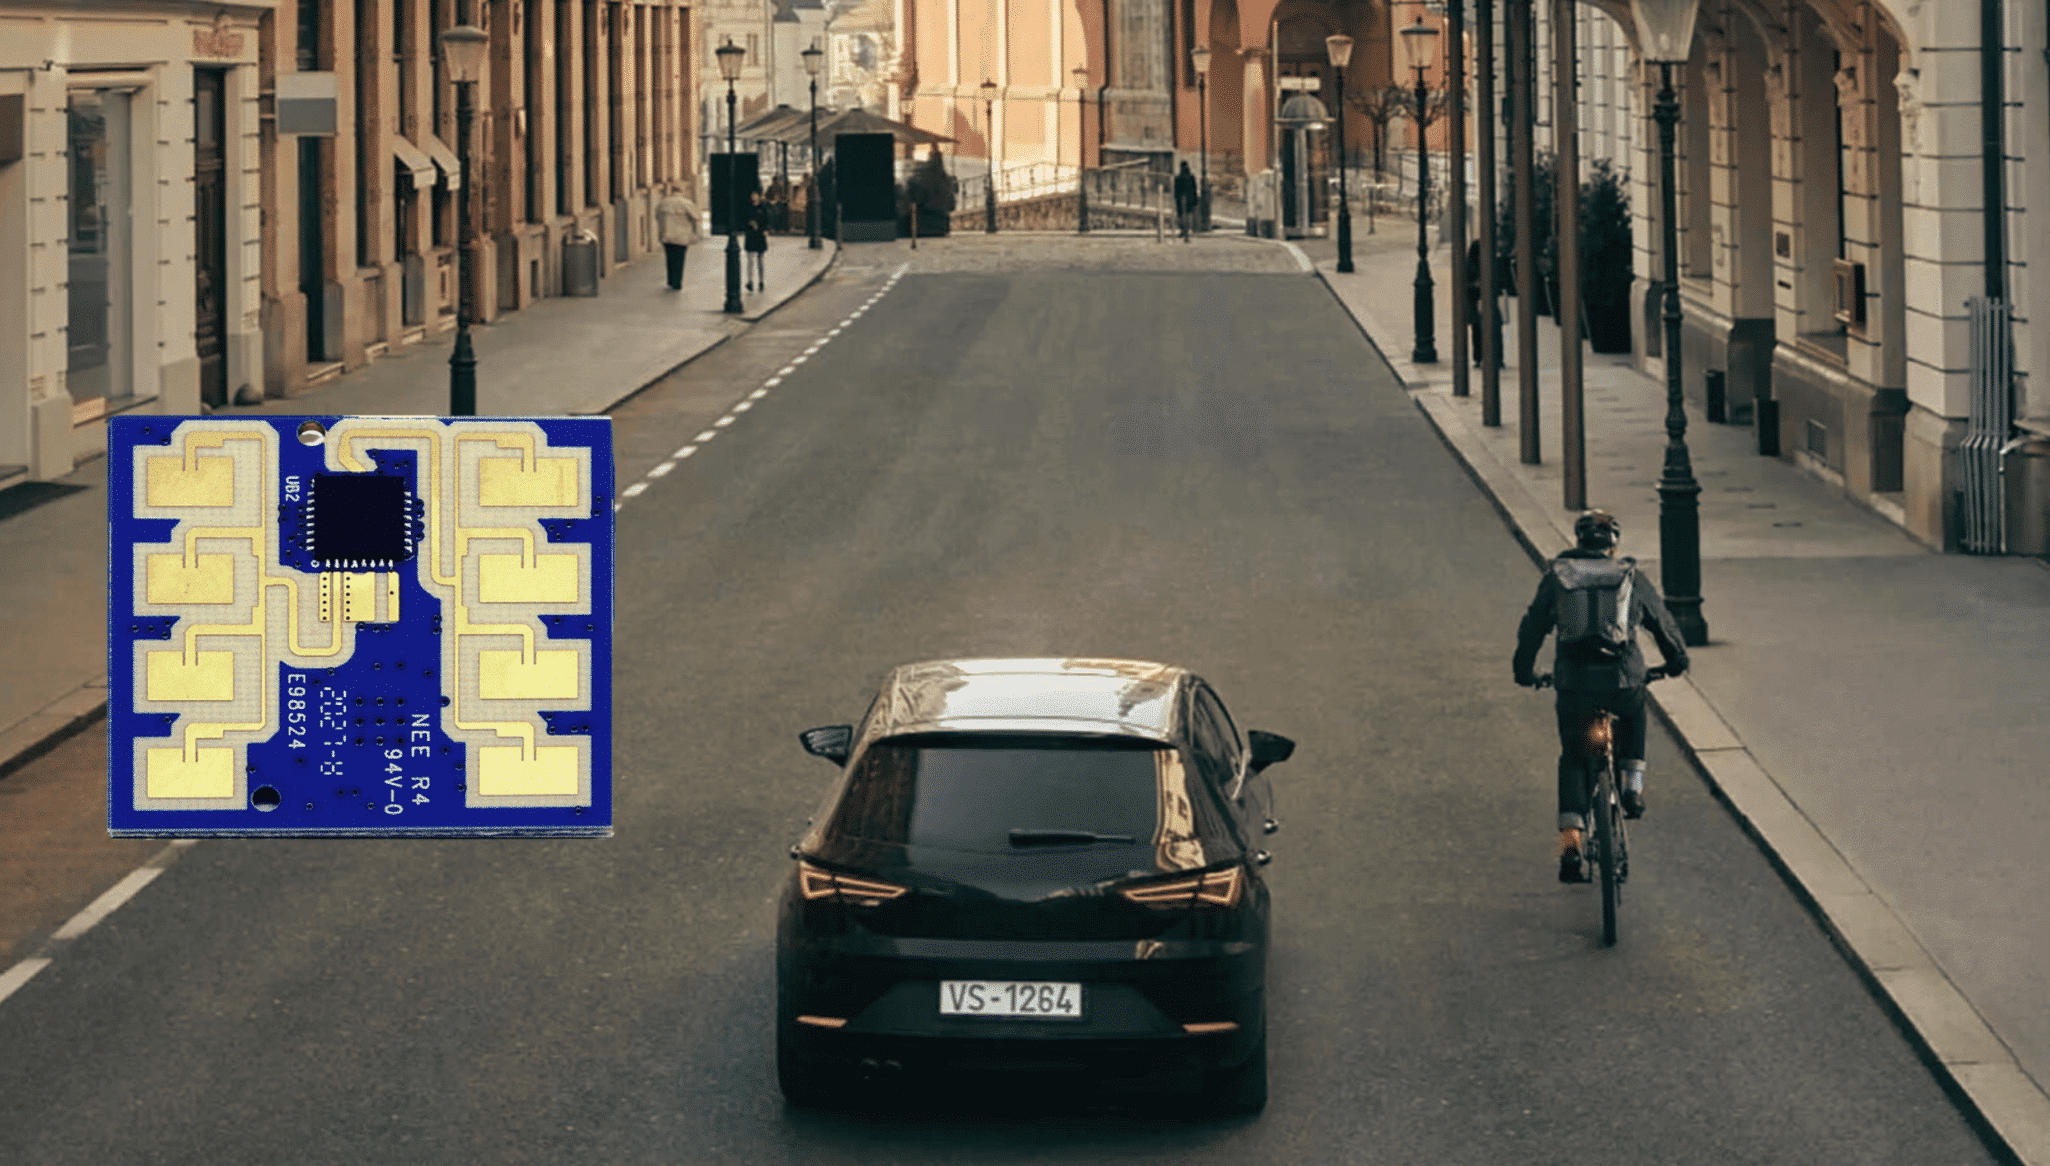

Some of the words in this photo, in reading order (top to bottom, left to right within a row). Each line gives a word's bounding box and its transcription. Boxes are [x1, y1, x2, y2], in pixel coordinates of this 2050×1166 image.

[285, 475, 300, 502] UB2
[288, 673, 306, 749] E98524
[411, 713, 431, 758] NEE
[384, 748, 404, 815] 94V-0
[411, 776, 431, 806] R4
[949, 984, 1073, 1013] VS-1264
